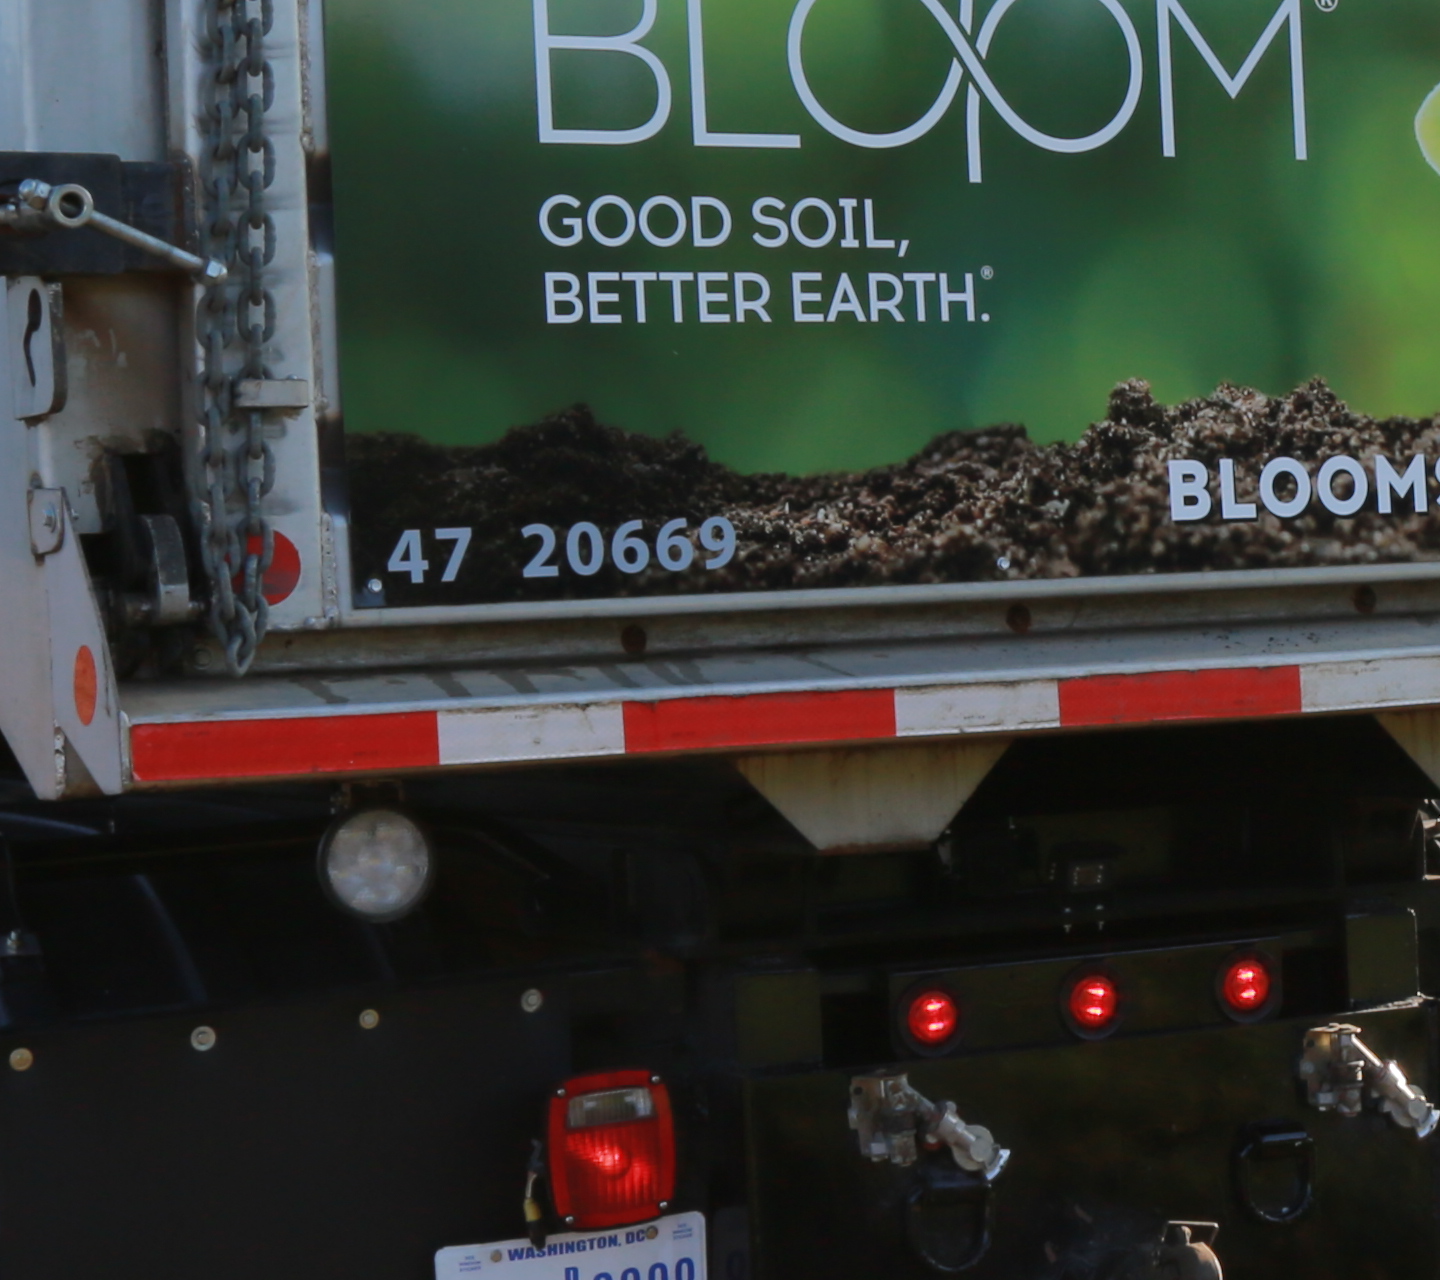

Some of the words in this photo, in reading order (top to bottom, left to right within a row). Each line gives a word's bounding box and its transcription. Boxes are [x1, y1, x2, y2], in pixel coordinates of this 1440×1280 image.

[538, 193, 733, 248] GOOD
[751, 196, 910, 258] SOIL,
[543, 270, 773, 324] BETTER
[387, 526, 473, 584] 47
[521, 515, 737, 579] 20669
[625, 1228, 647, 1245] DC
